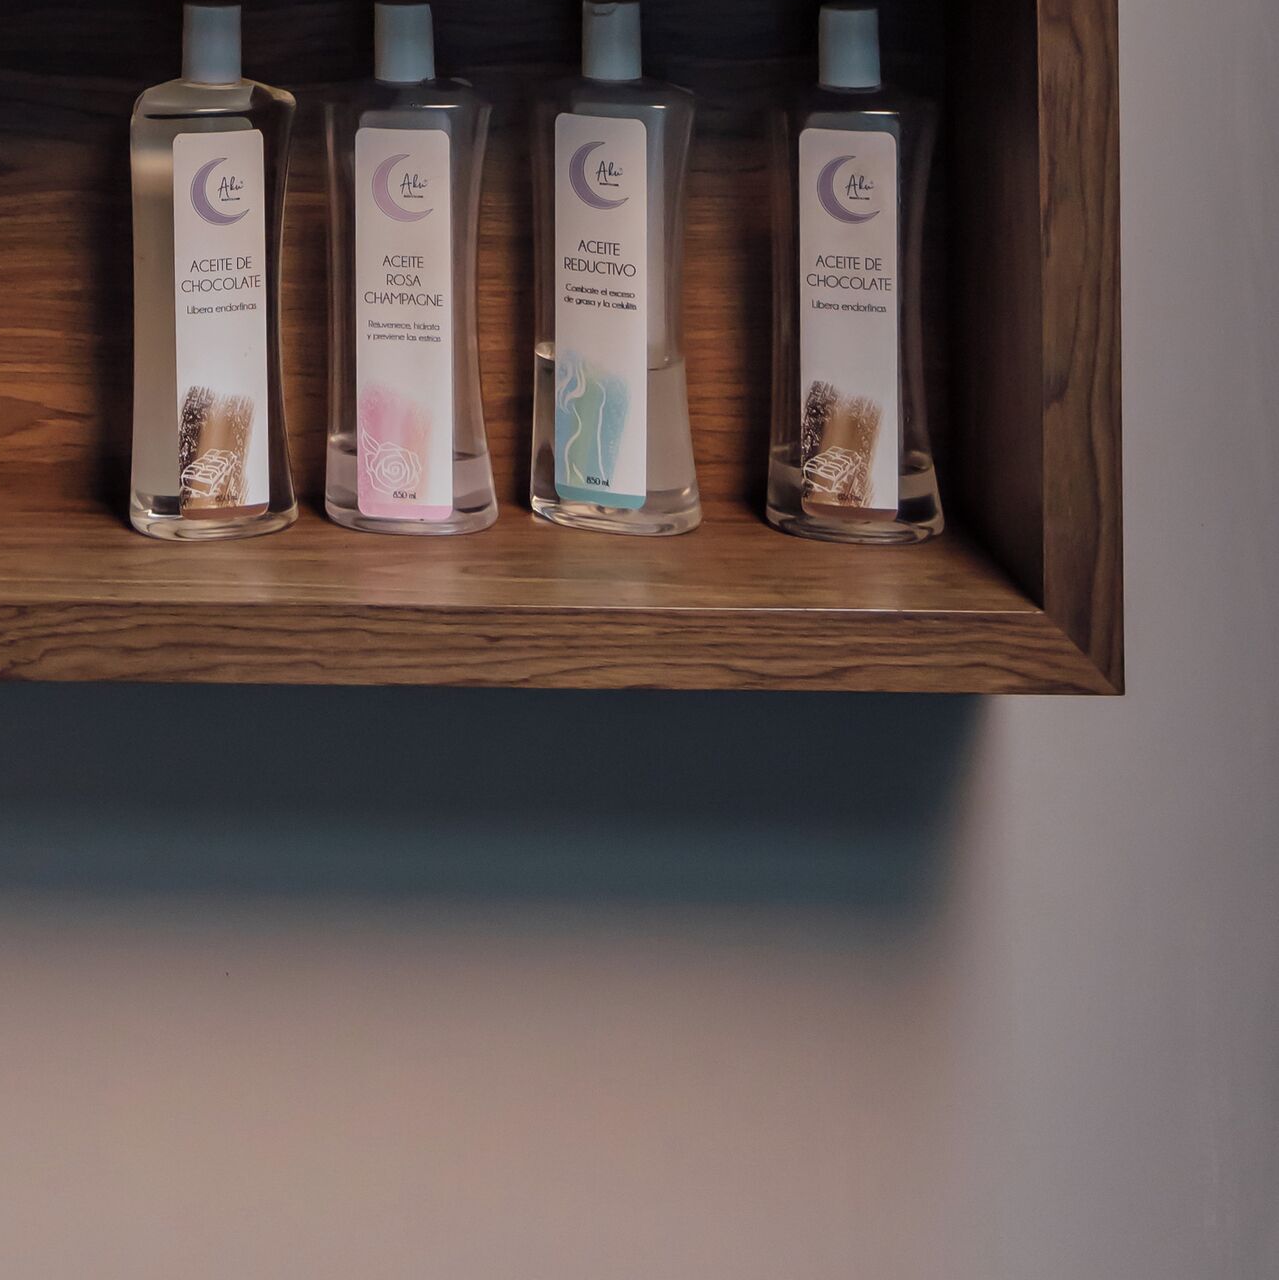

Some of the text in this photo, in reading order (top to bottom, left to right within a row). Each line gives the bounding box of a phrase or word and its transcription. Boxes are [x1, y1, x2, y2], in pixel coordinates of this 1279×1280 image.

[578, 239, 621, 256] ACEITE
[190, 256, 252, 273] ACEITE DE
[382, 255, 424, 269] ACEITE
[564, 257, 637, 278] REDUCTIVO
[815, 255, 882, 271] ACEITE DE
[181, 275, 261, 293] CHOCOLATE
[386, 274, 422, 287] ROSA
[806, 273, 892, 291] CHOCOLATE
[565, 283, 636, 299] Combate el exceso
[363, 291, 444, 307] CHAMPAGNE
[563, 295, 574, 303] de
[575, 297, 596, 307] grasa
[602, 299, 611, 308] la
[811, 299, 887, 313] Libera endorfinas
[187, 302, 257, 315] Libera endorfinas
[413, 321, 440, 331] hidrata
[372, 333, 405, 341] previene
[406, 332, 417, 341] las
[586, 476, 601, 486] 850
[392, 490, 408, 499] 850
